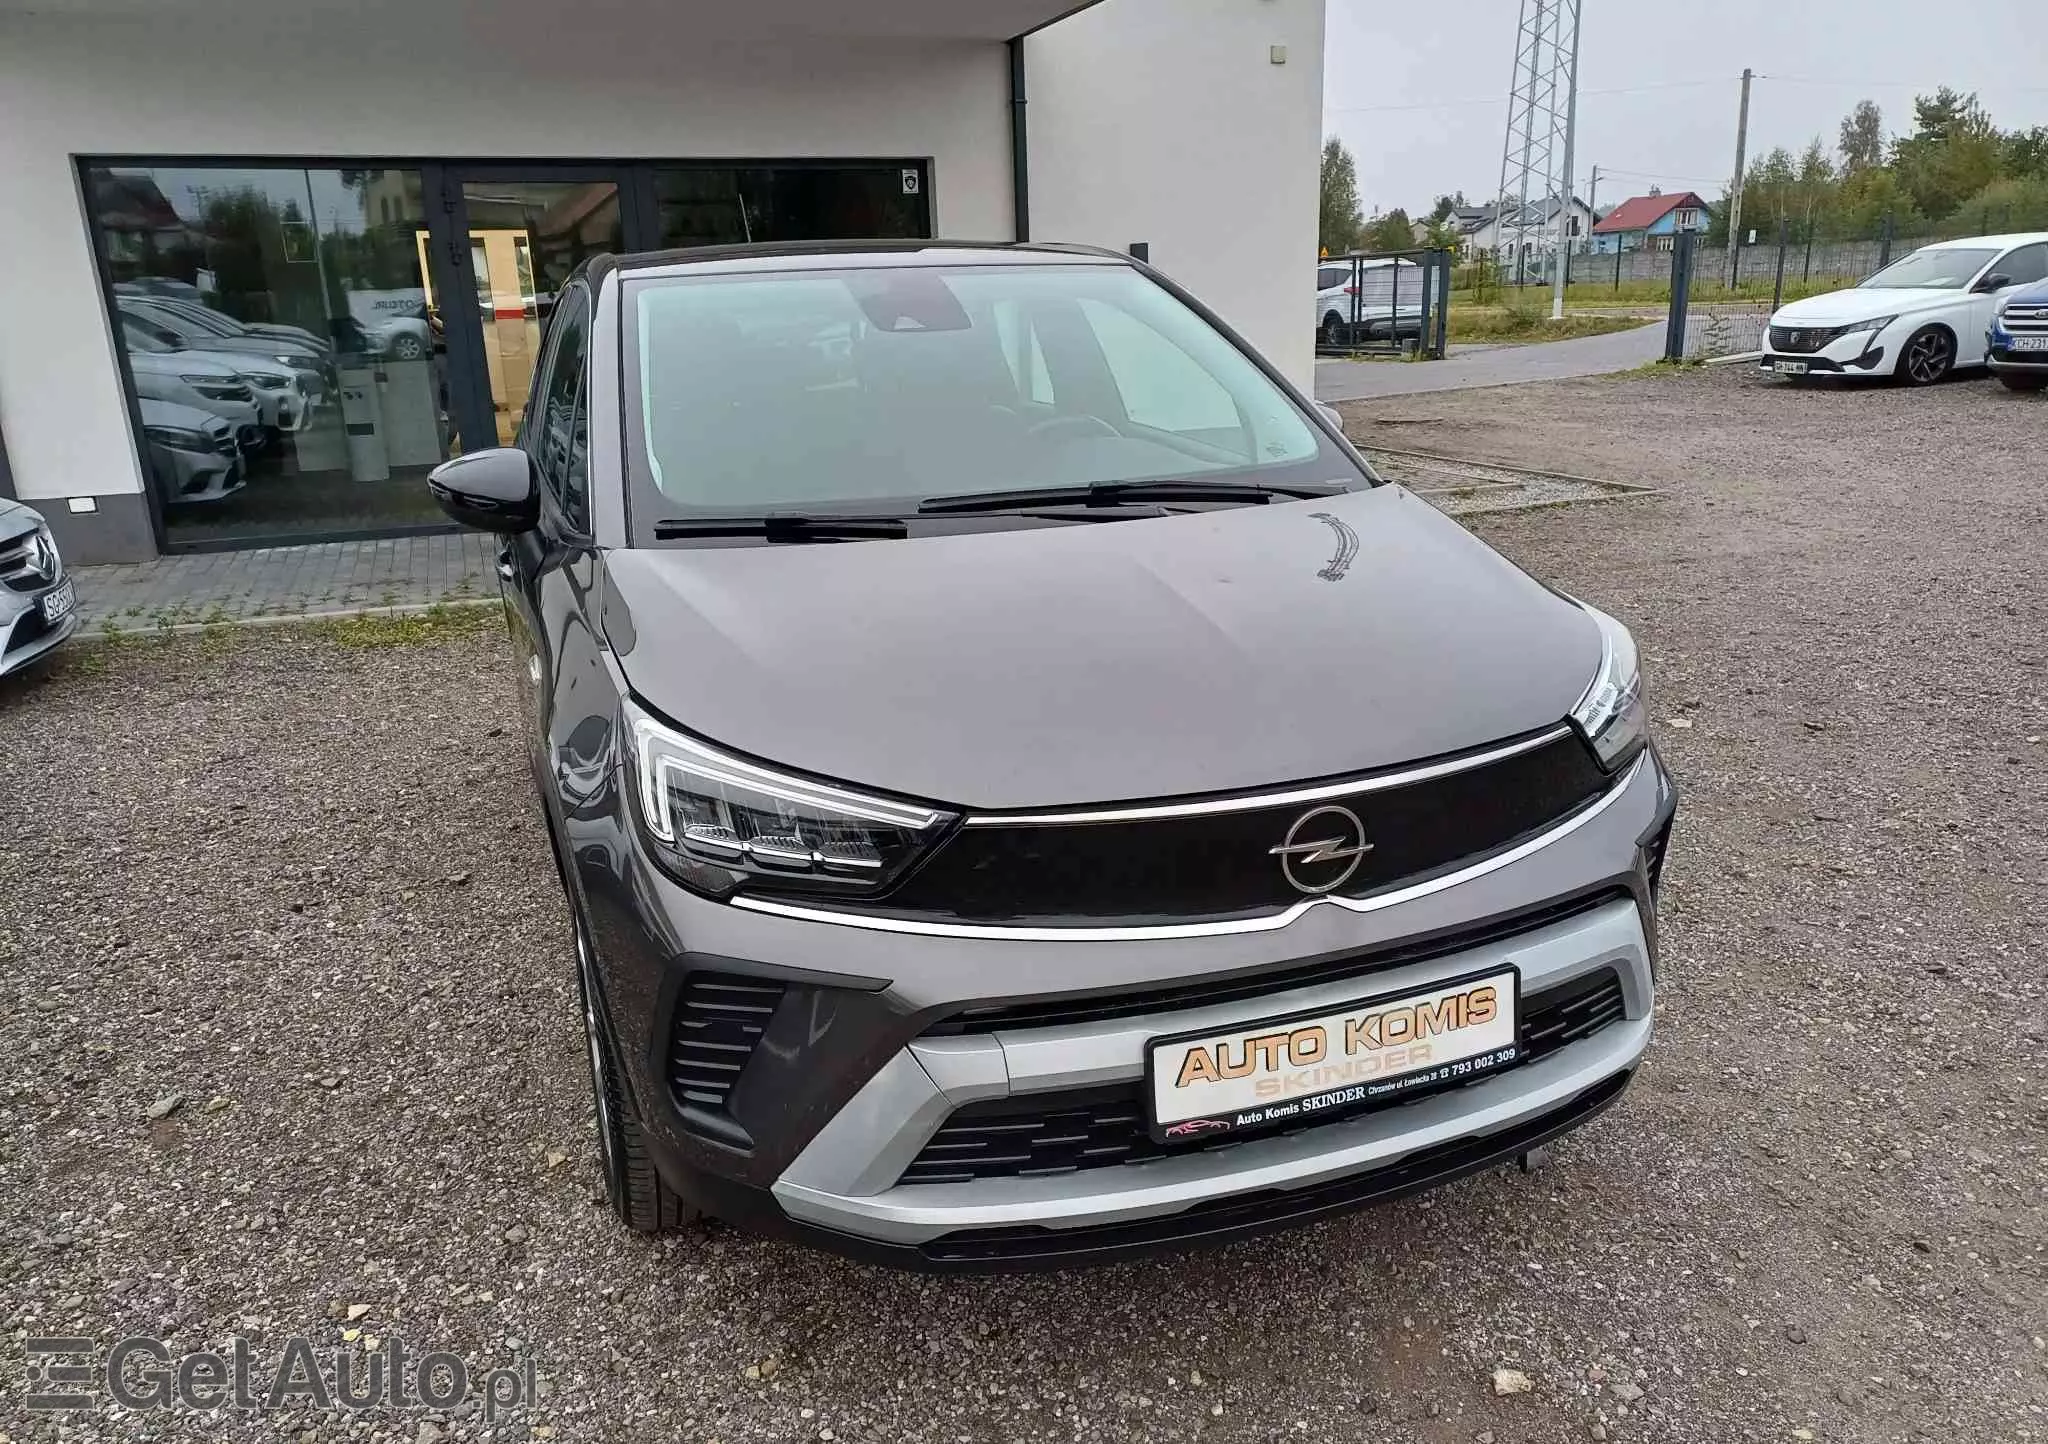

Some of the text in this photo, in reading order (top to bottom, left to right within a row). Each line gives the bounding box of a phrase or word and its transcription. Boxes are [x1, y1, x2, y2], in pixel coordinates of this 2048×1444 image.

[1175, 985, 1498, 1089] AUTO KOMIS
[1255, 1044, 1432, 1098] SKINDER
[1236, 1114, 1263, 1127] Auto
[1265, 1103, 1300, 1121] Komis
[1302, 1086, 1366, 1112] SKINDER
[1451, 1061, 1473, 1076] 793
[1474, 1055, 1495, 1071] 002
[1496, 1047, 1516, 1064] 309
